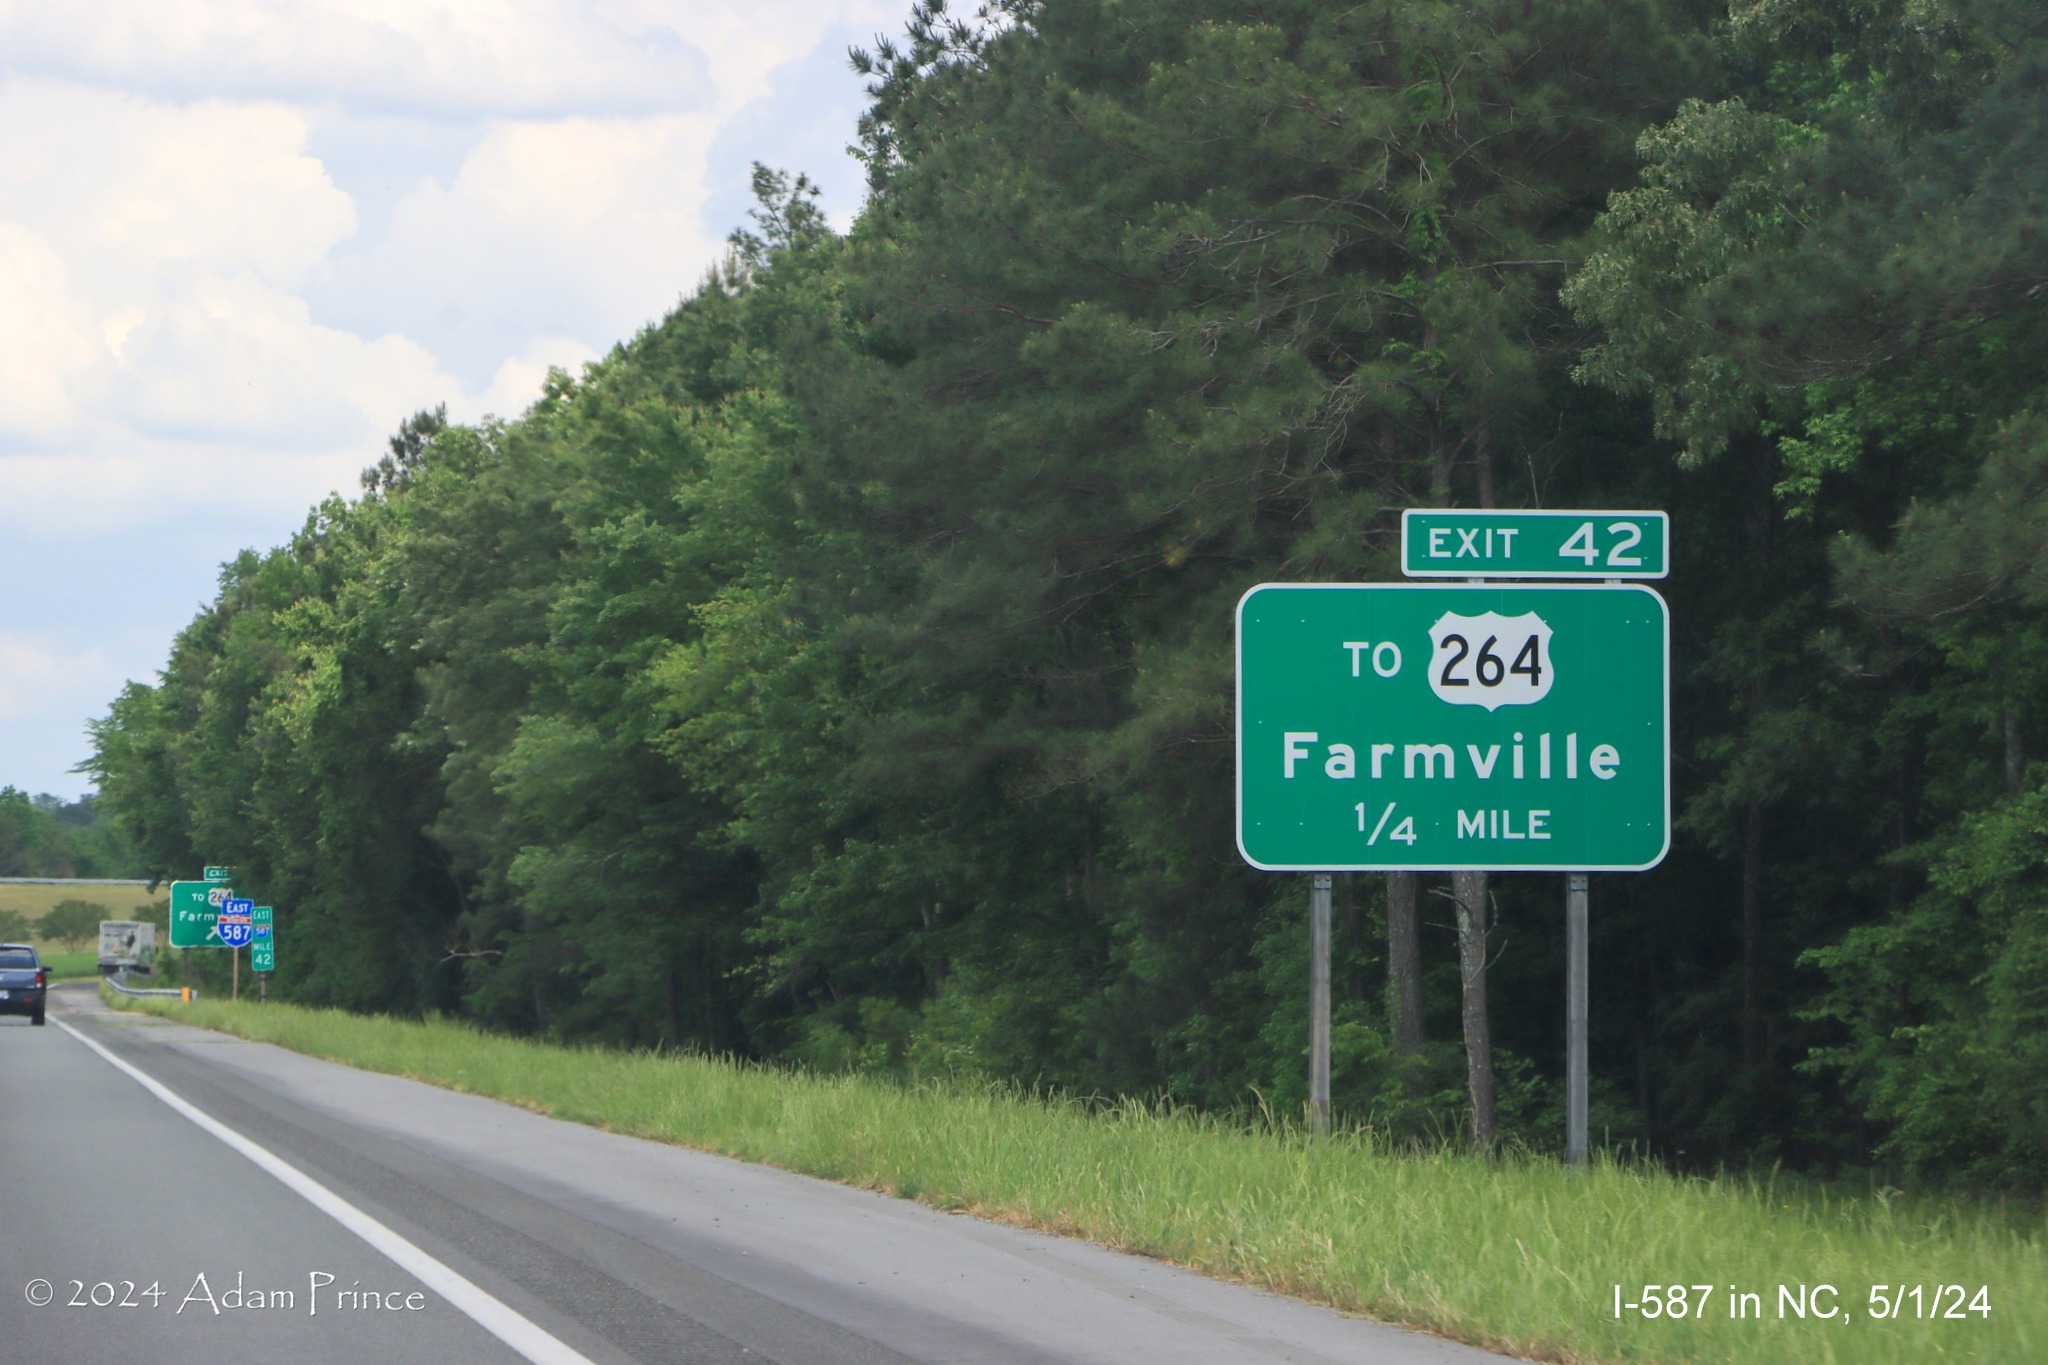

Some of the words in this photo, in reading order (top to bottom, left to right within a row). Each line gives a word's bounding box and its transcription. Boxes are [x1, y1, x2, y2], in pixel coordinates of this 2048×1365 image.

[1428, 527, 1519, 559] EXIT
[1558, 521, 1642, 567] 42
[1343, 640, 1402, 678] TO
[1439, 633, 1542, 688] 264
[1283, 731, 1621, 780] Farmville
[1354, 801, 1418, 846] 1/4
[1456, 809, 1552, 840] MILE
[192, 893, 205, 902] TO
[226, 901, 249, 914] EAST
[253, 910, 269, 920] EAST
[224, 925, 251, 941] 587
[255, 927, 270, 935] 587
[253, 942, 271, 951] MILE
[255, 953, 271, 965] 42
